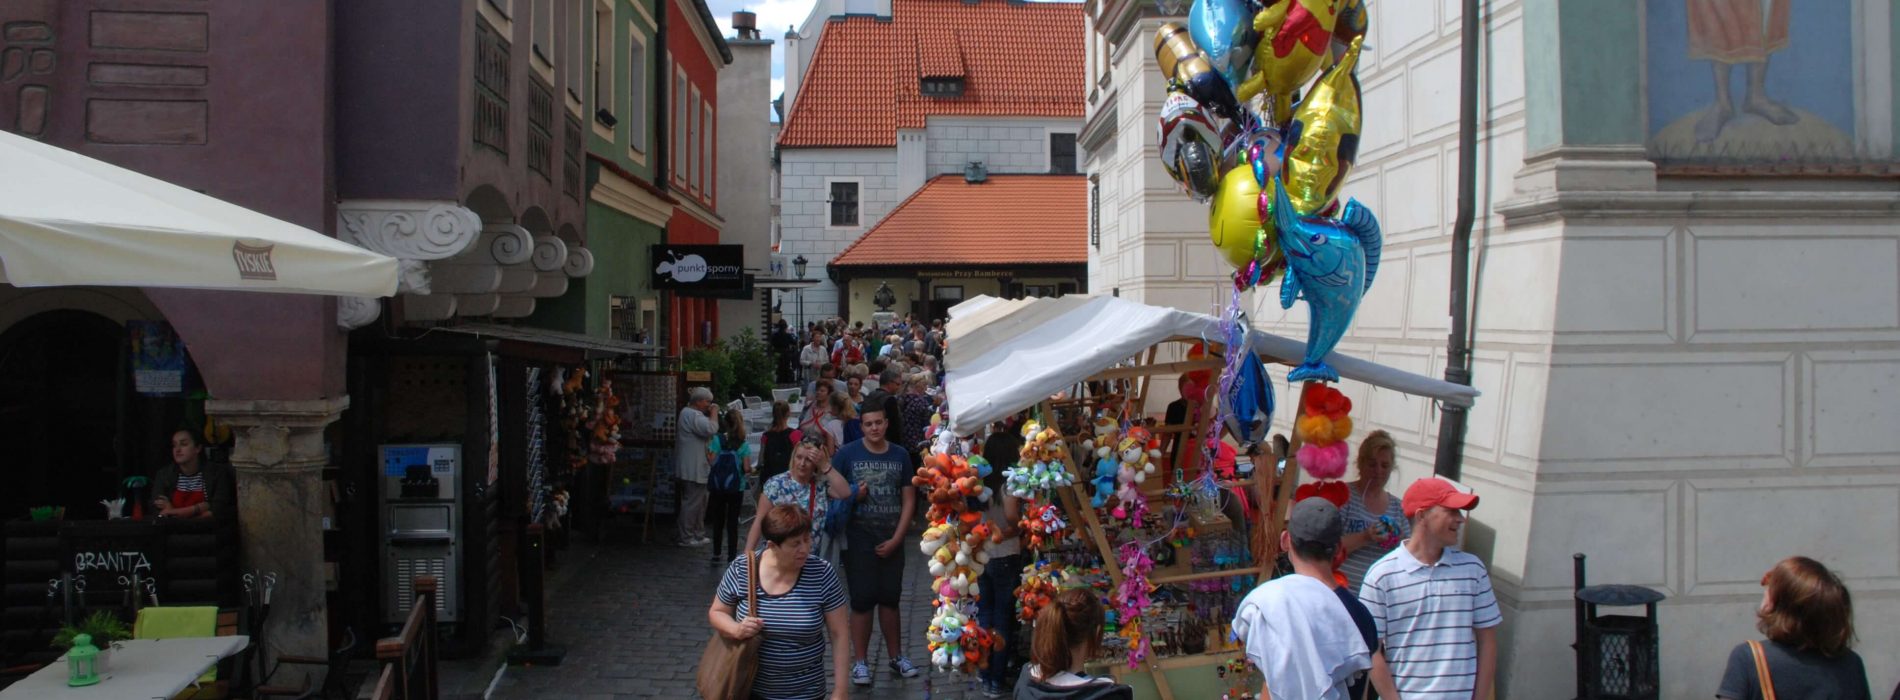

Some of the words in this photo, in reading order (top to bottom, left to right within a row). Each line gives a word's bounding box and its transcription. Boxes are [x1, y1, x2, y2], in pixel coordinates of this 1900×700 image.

[234, 249, 273, 273] TYSKIE
[677, 263, 706, 275] punkt
[707, 265, 740, 276] sporny
[954, 270, 973, 279] Przy
